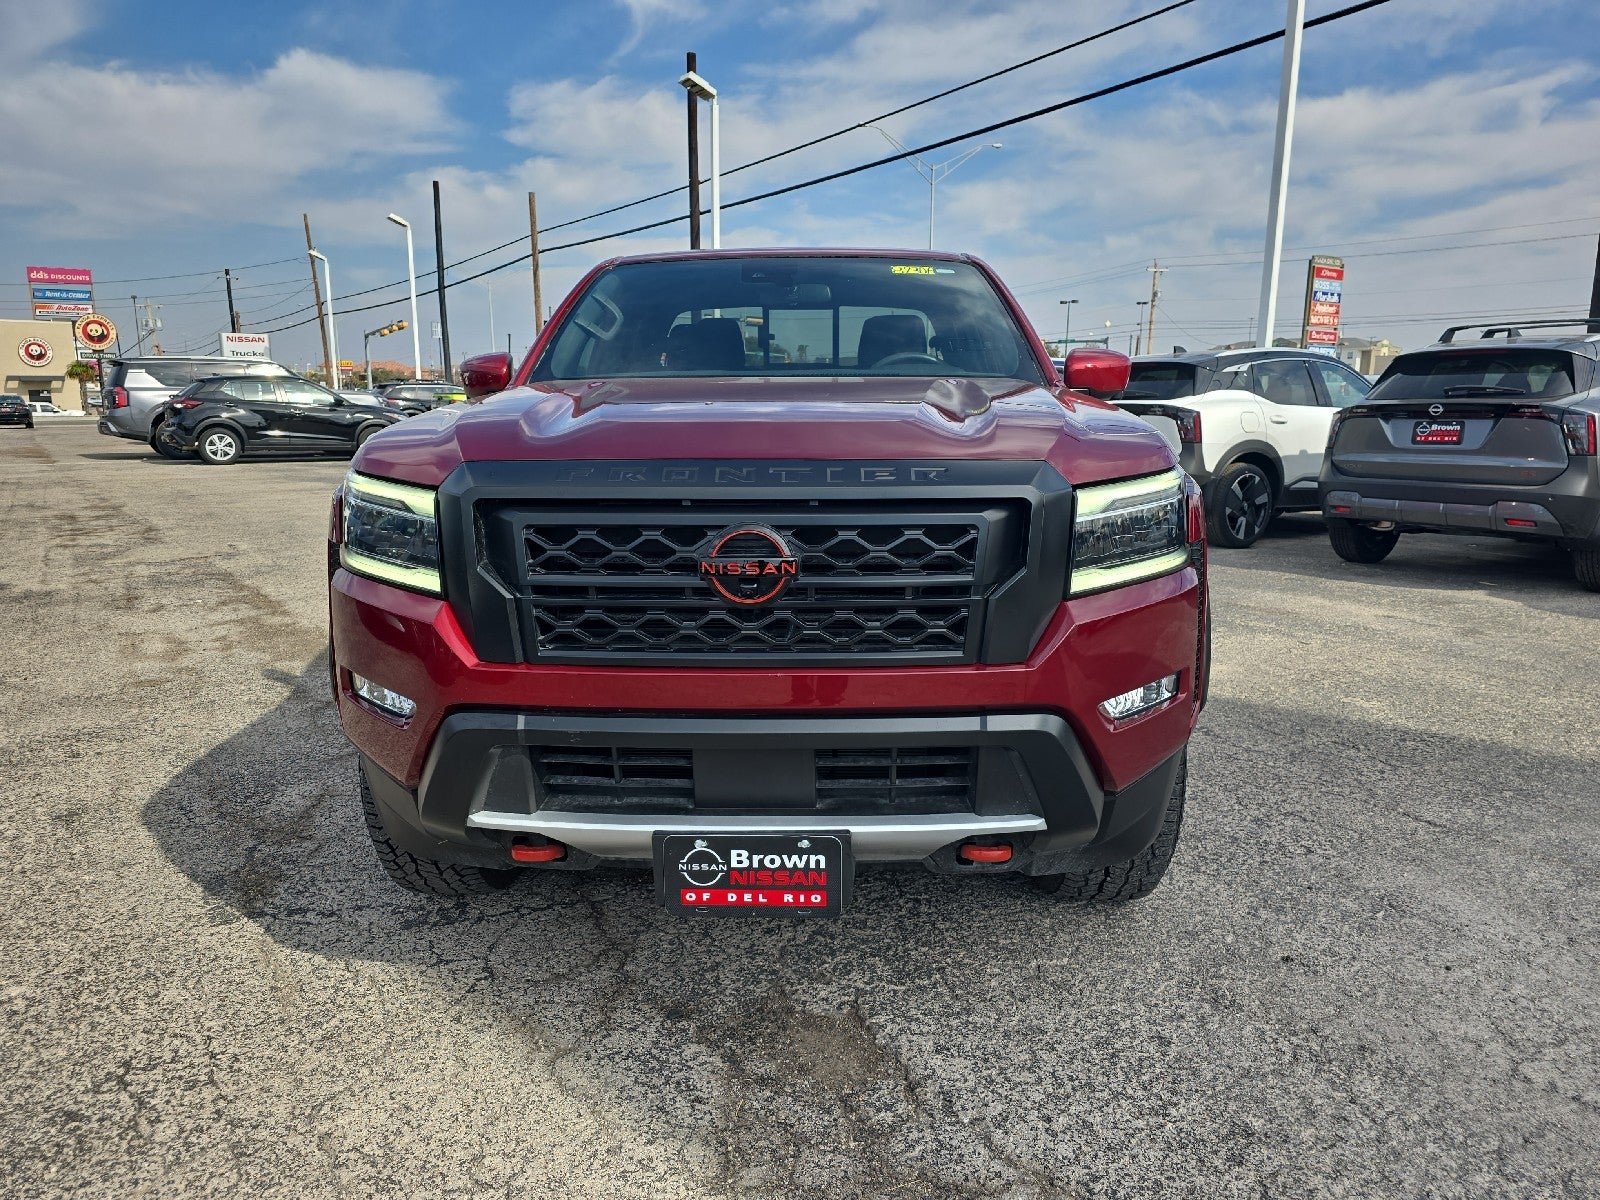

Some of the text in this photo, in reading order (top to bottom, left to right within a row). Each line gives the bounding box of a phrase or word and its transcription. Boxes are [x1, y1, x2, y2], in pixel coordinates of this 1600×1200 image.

[30, 270, 49, 279] dd's
[55, 304, 90, 312] AutoZone
[555, 466, 951, 483] FRONTIER
[701, 561, 796, 575] NISSAN
[730, 850, 826, 869] Brown
[678, 863, 727, 871] NISSAN
[730, 871, 827, 886] NISSAN
[685, 892, 822, 903] OF DEL RIO
